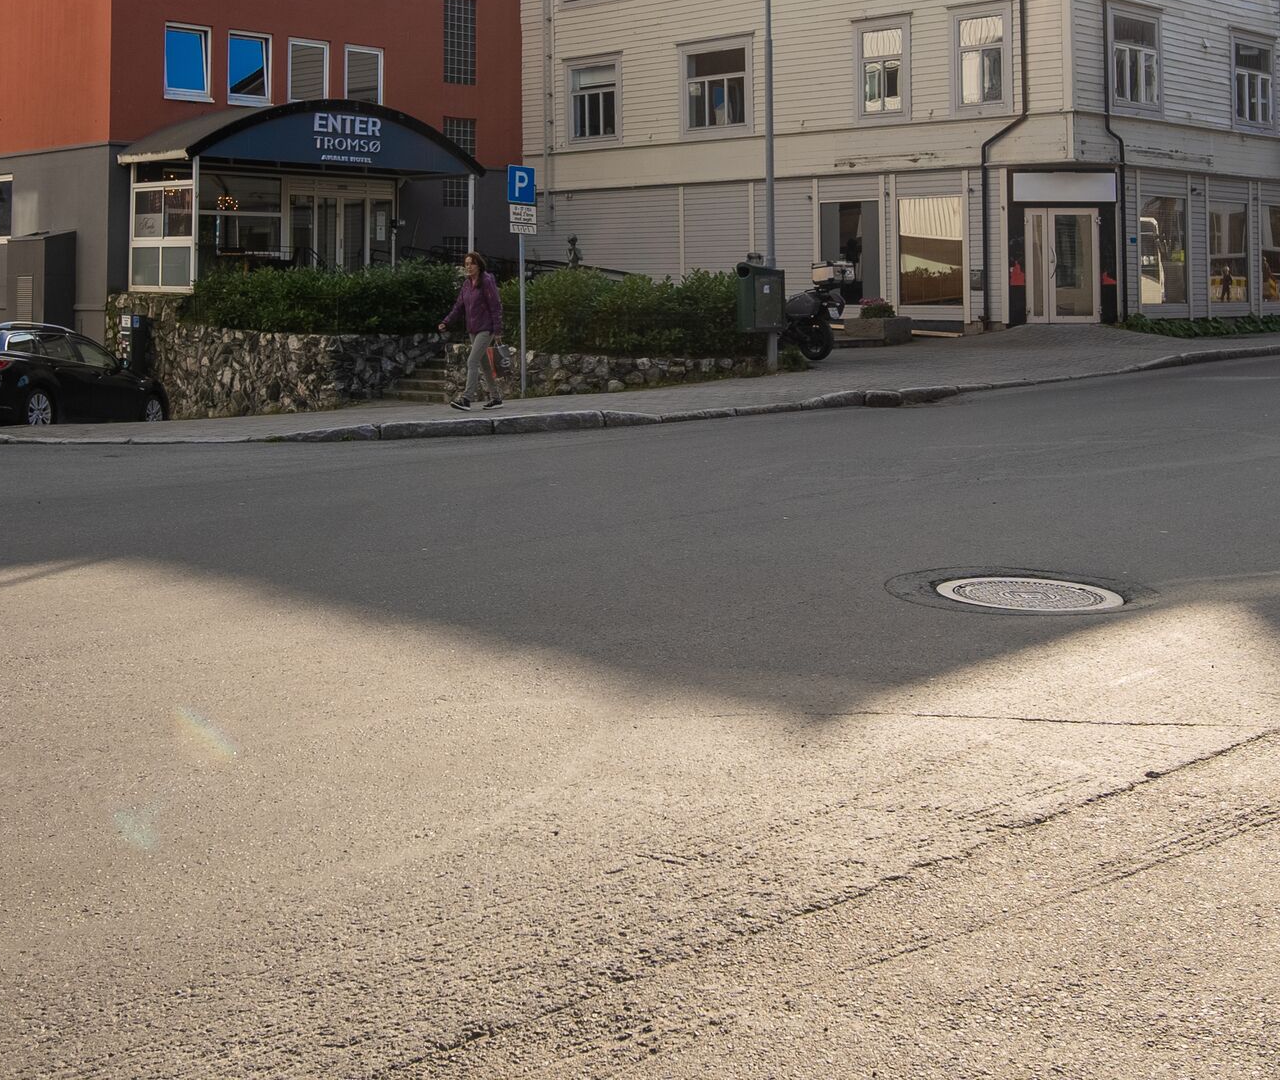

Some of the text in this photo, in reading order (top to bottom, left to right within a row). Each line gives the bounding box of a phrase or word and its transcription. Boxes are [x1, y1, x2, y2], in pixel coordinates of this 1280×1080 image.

[313, 112, 381, 137] ENTER
[313, 135, 381, 153] TROMSØ
[515, 170, 529, 198] P
